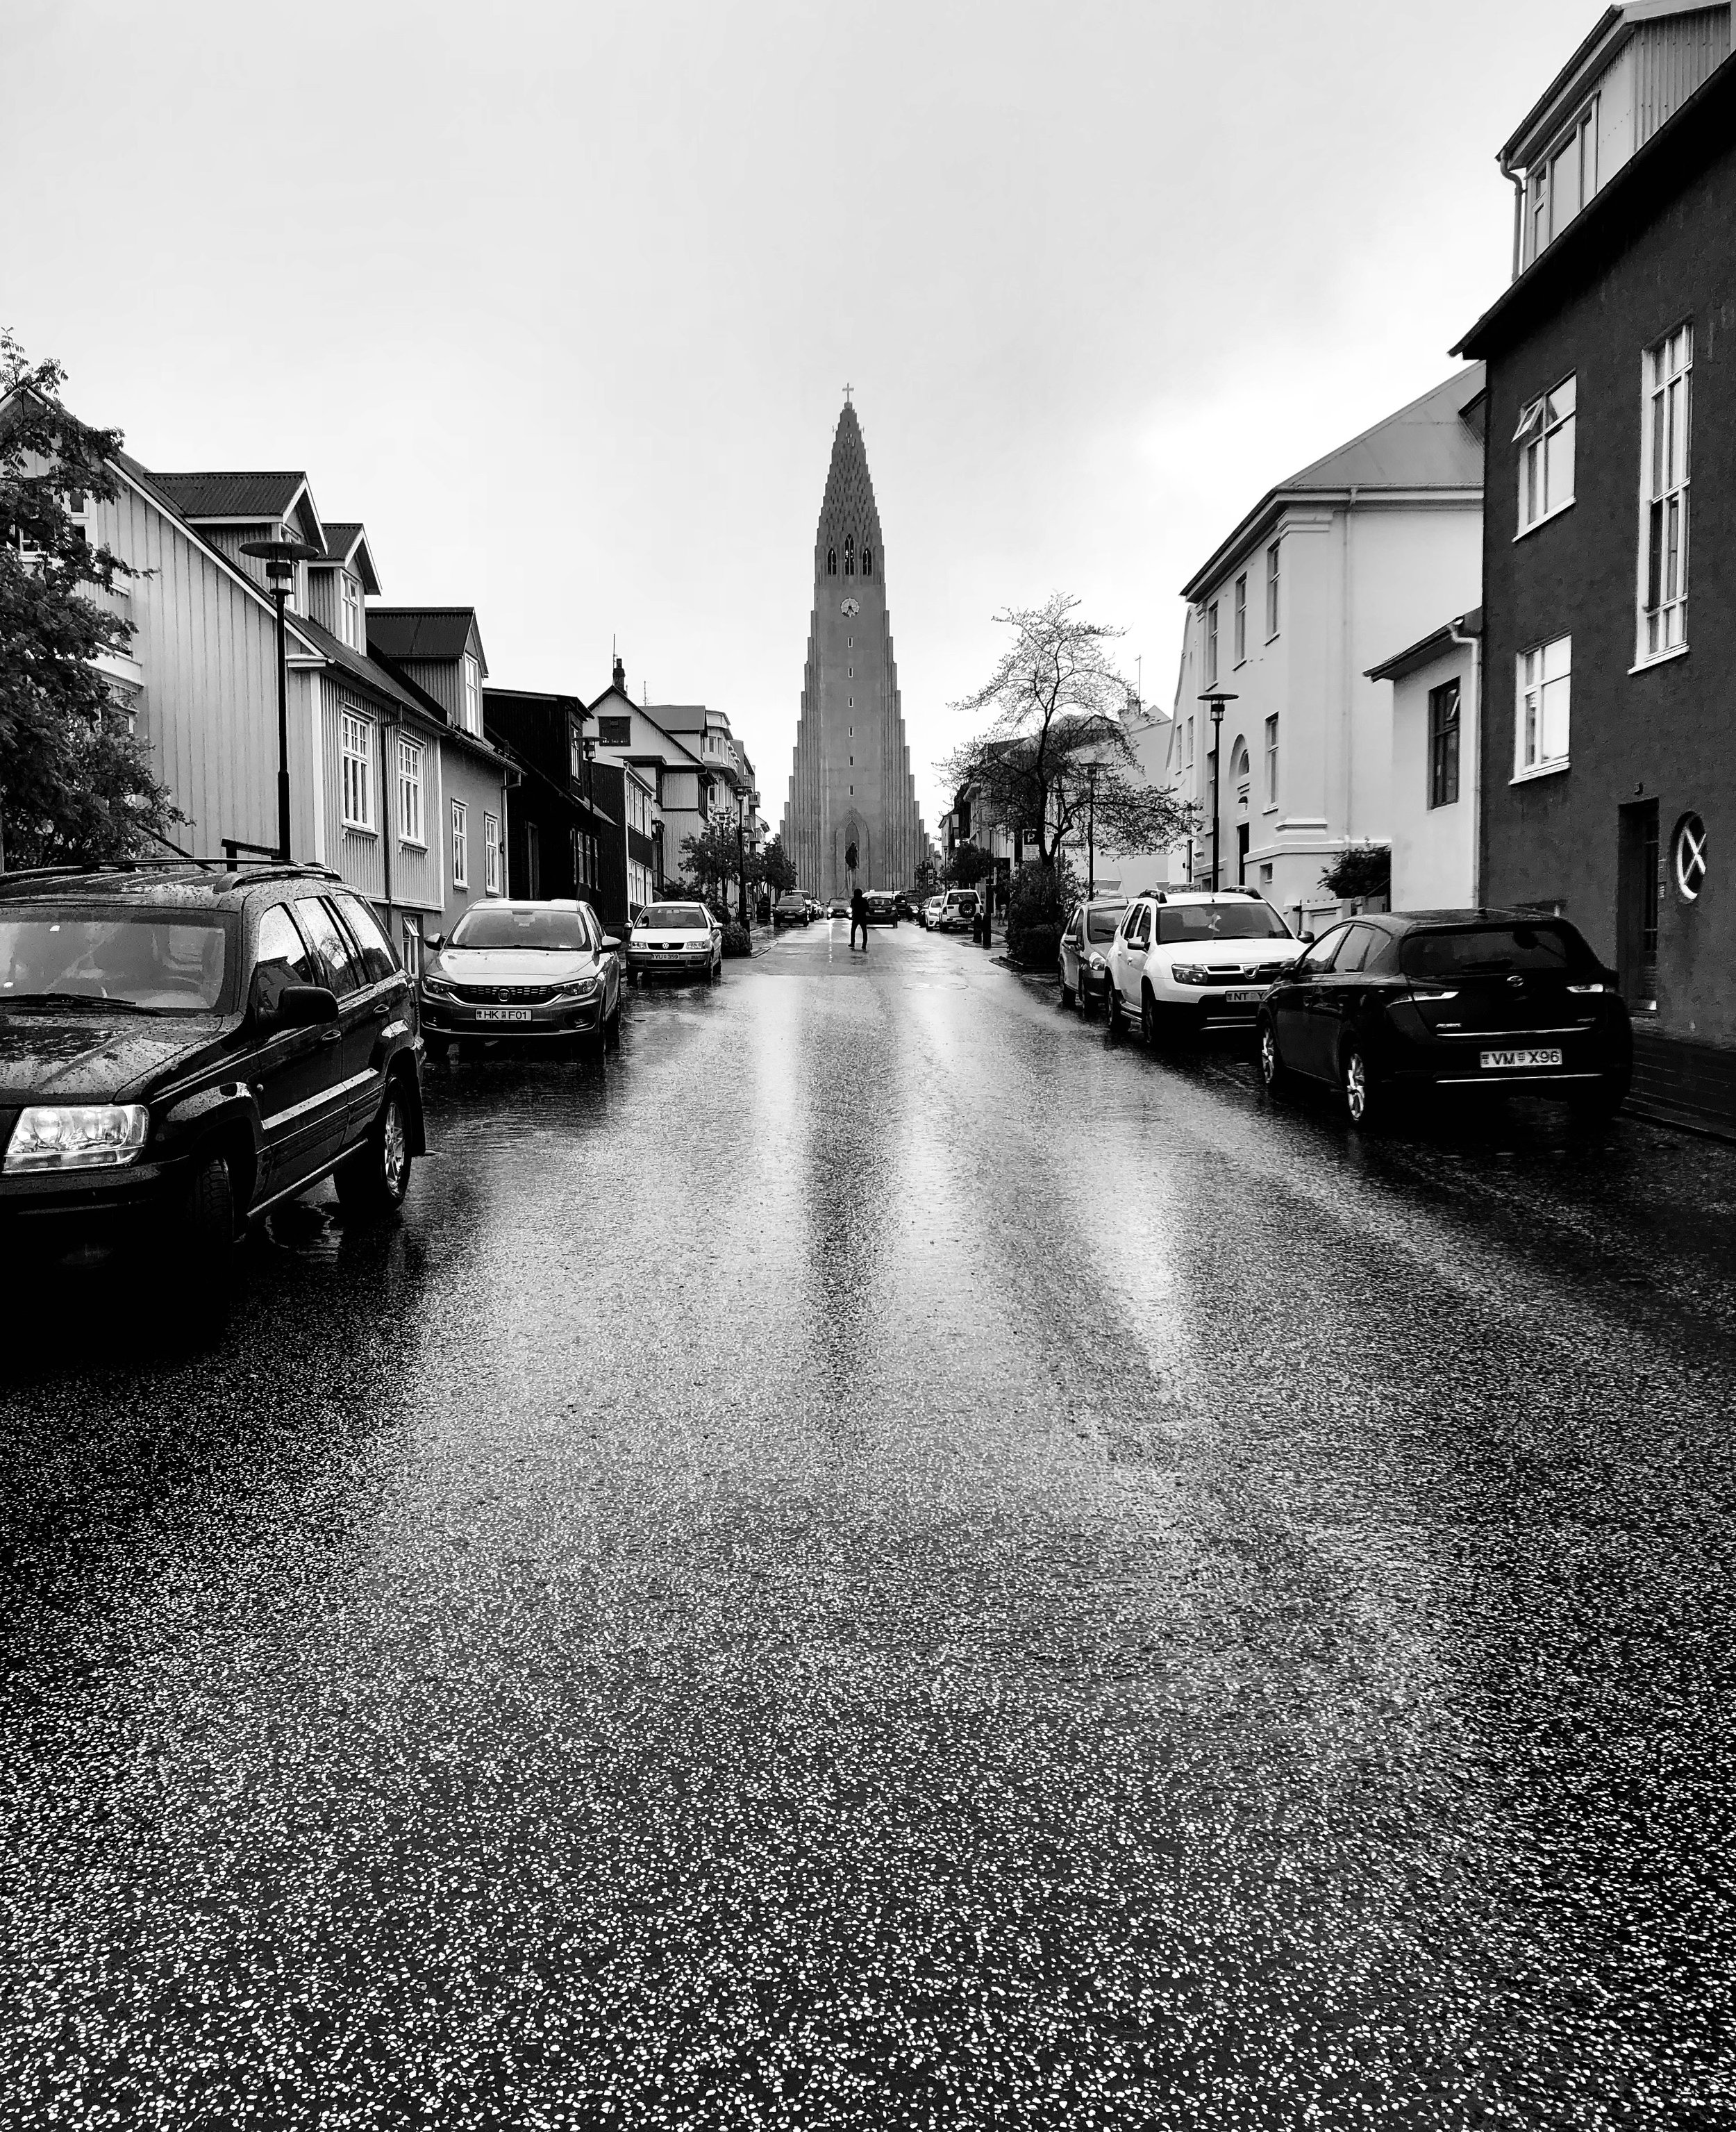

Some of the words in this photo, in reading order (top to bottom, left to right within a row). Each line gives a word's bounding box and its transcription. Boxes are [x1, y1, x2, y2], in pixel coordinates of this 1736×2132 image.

[1234, 992, 1249, 1001] NT
[484, 1010, 499, 1019] HK
[508, 1011, 526, 1019] F01
[1528, 1051, 1560, 1064] X96
